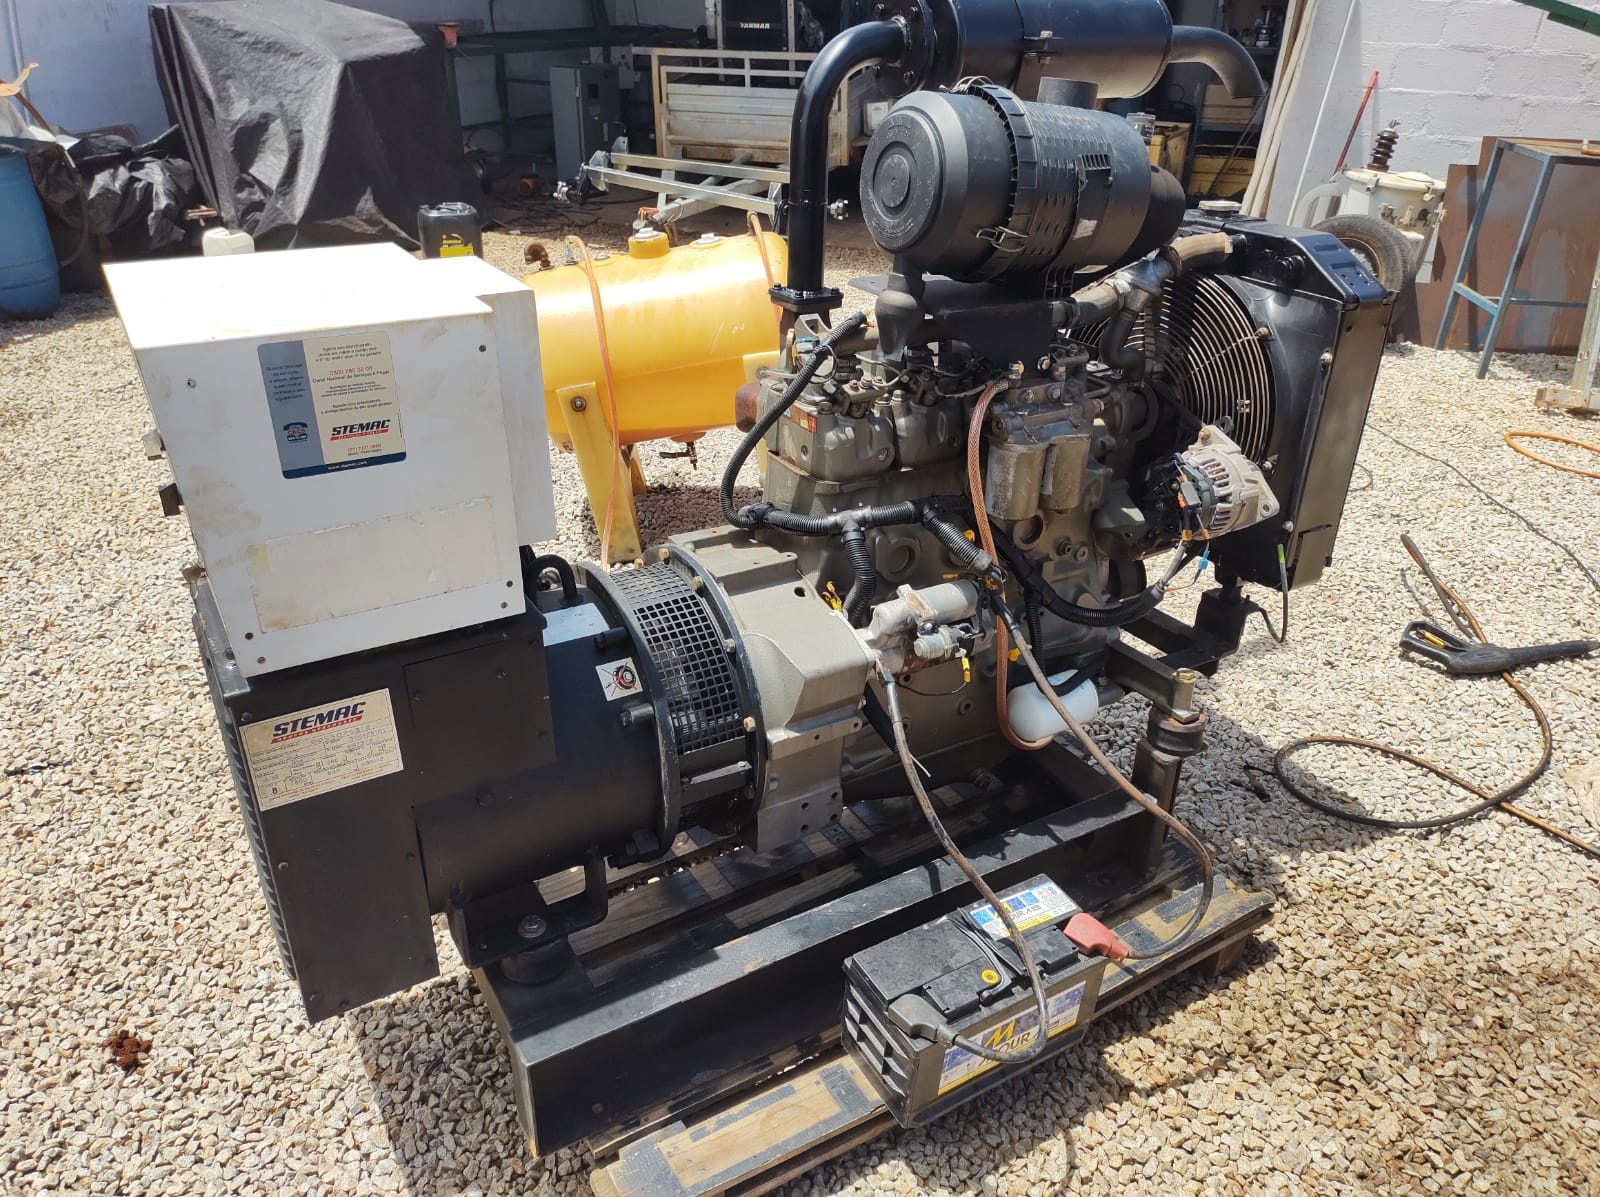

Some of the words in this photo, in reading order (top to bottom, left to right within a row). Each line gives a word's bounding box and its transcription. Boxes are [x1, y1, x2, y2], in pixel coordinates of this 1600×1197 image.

[739, 22, 770, 30] YANMAR
[331, 419, 391, 436] STEMAC
[273, 701, 367, 738] STEMAC
